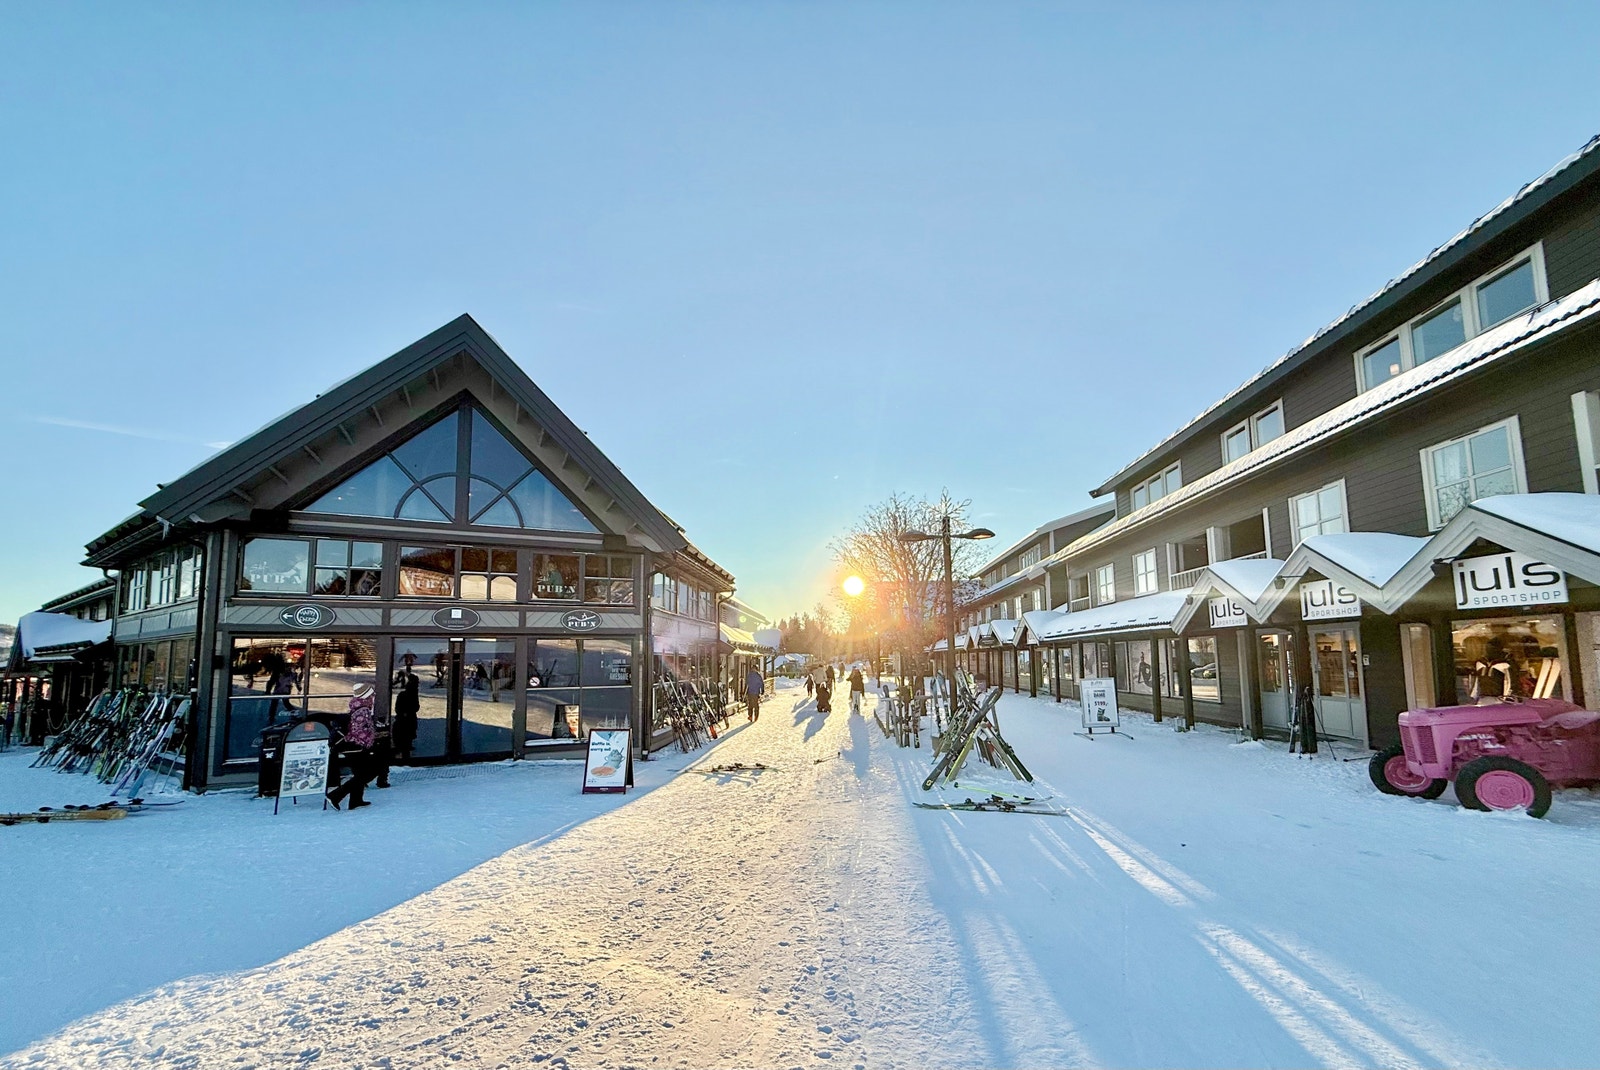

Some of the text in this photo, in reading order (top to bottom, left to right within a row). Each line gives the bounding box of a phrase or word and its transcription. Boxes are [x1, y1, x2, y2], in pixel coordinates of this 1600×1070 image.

[1457, 556, 1561, 606] juls
[1302, 582, 1357, 618] juls
[1473, 590, 1561, 605] SPORTSHOP
[1210, 598, 1245, 626] juls
[1216, 618, 1246, 627] SPORTSHOP
[1310, 607, 1358, 618] SPORTSHOP
